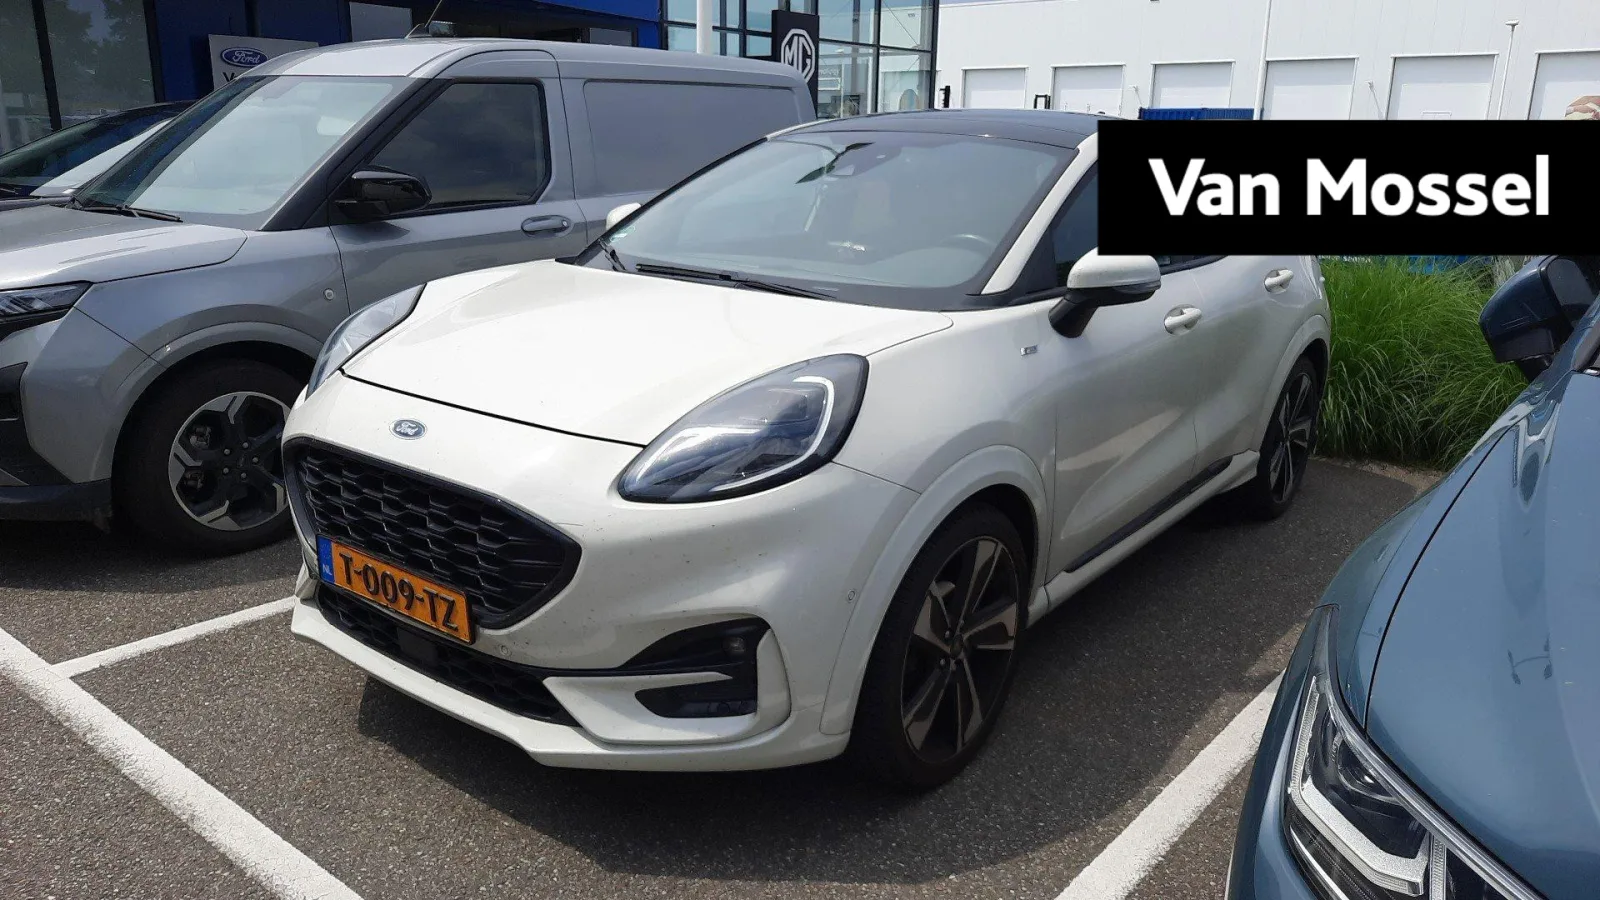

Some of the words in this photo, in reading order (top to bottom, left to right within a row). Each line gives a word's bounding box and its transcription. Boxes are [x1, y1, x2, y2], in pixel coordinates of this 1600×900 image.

[232, 50, 261, 64] Ford
[784, 35, 812, 80] MG
[396, 421, 419, 436] Ford
[322, 563, 333, 576] NL
[339, 552, 459, 632] T-009-TZ
